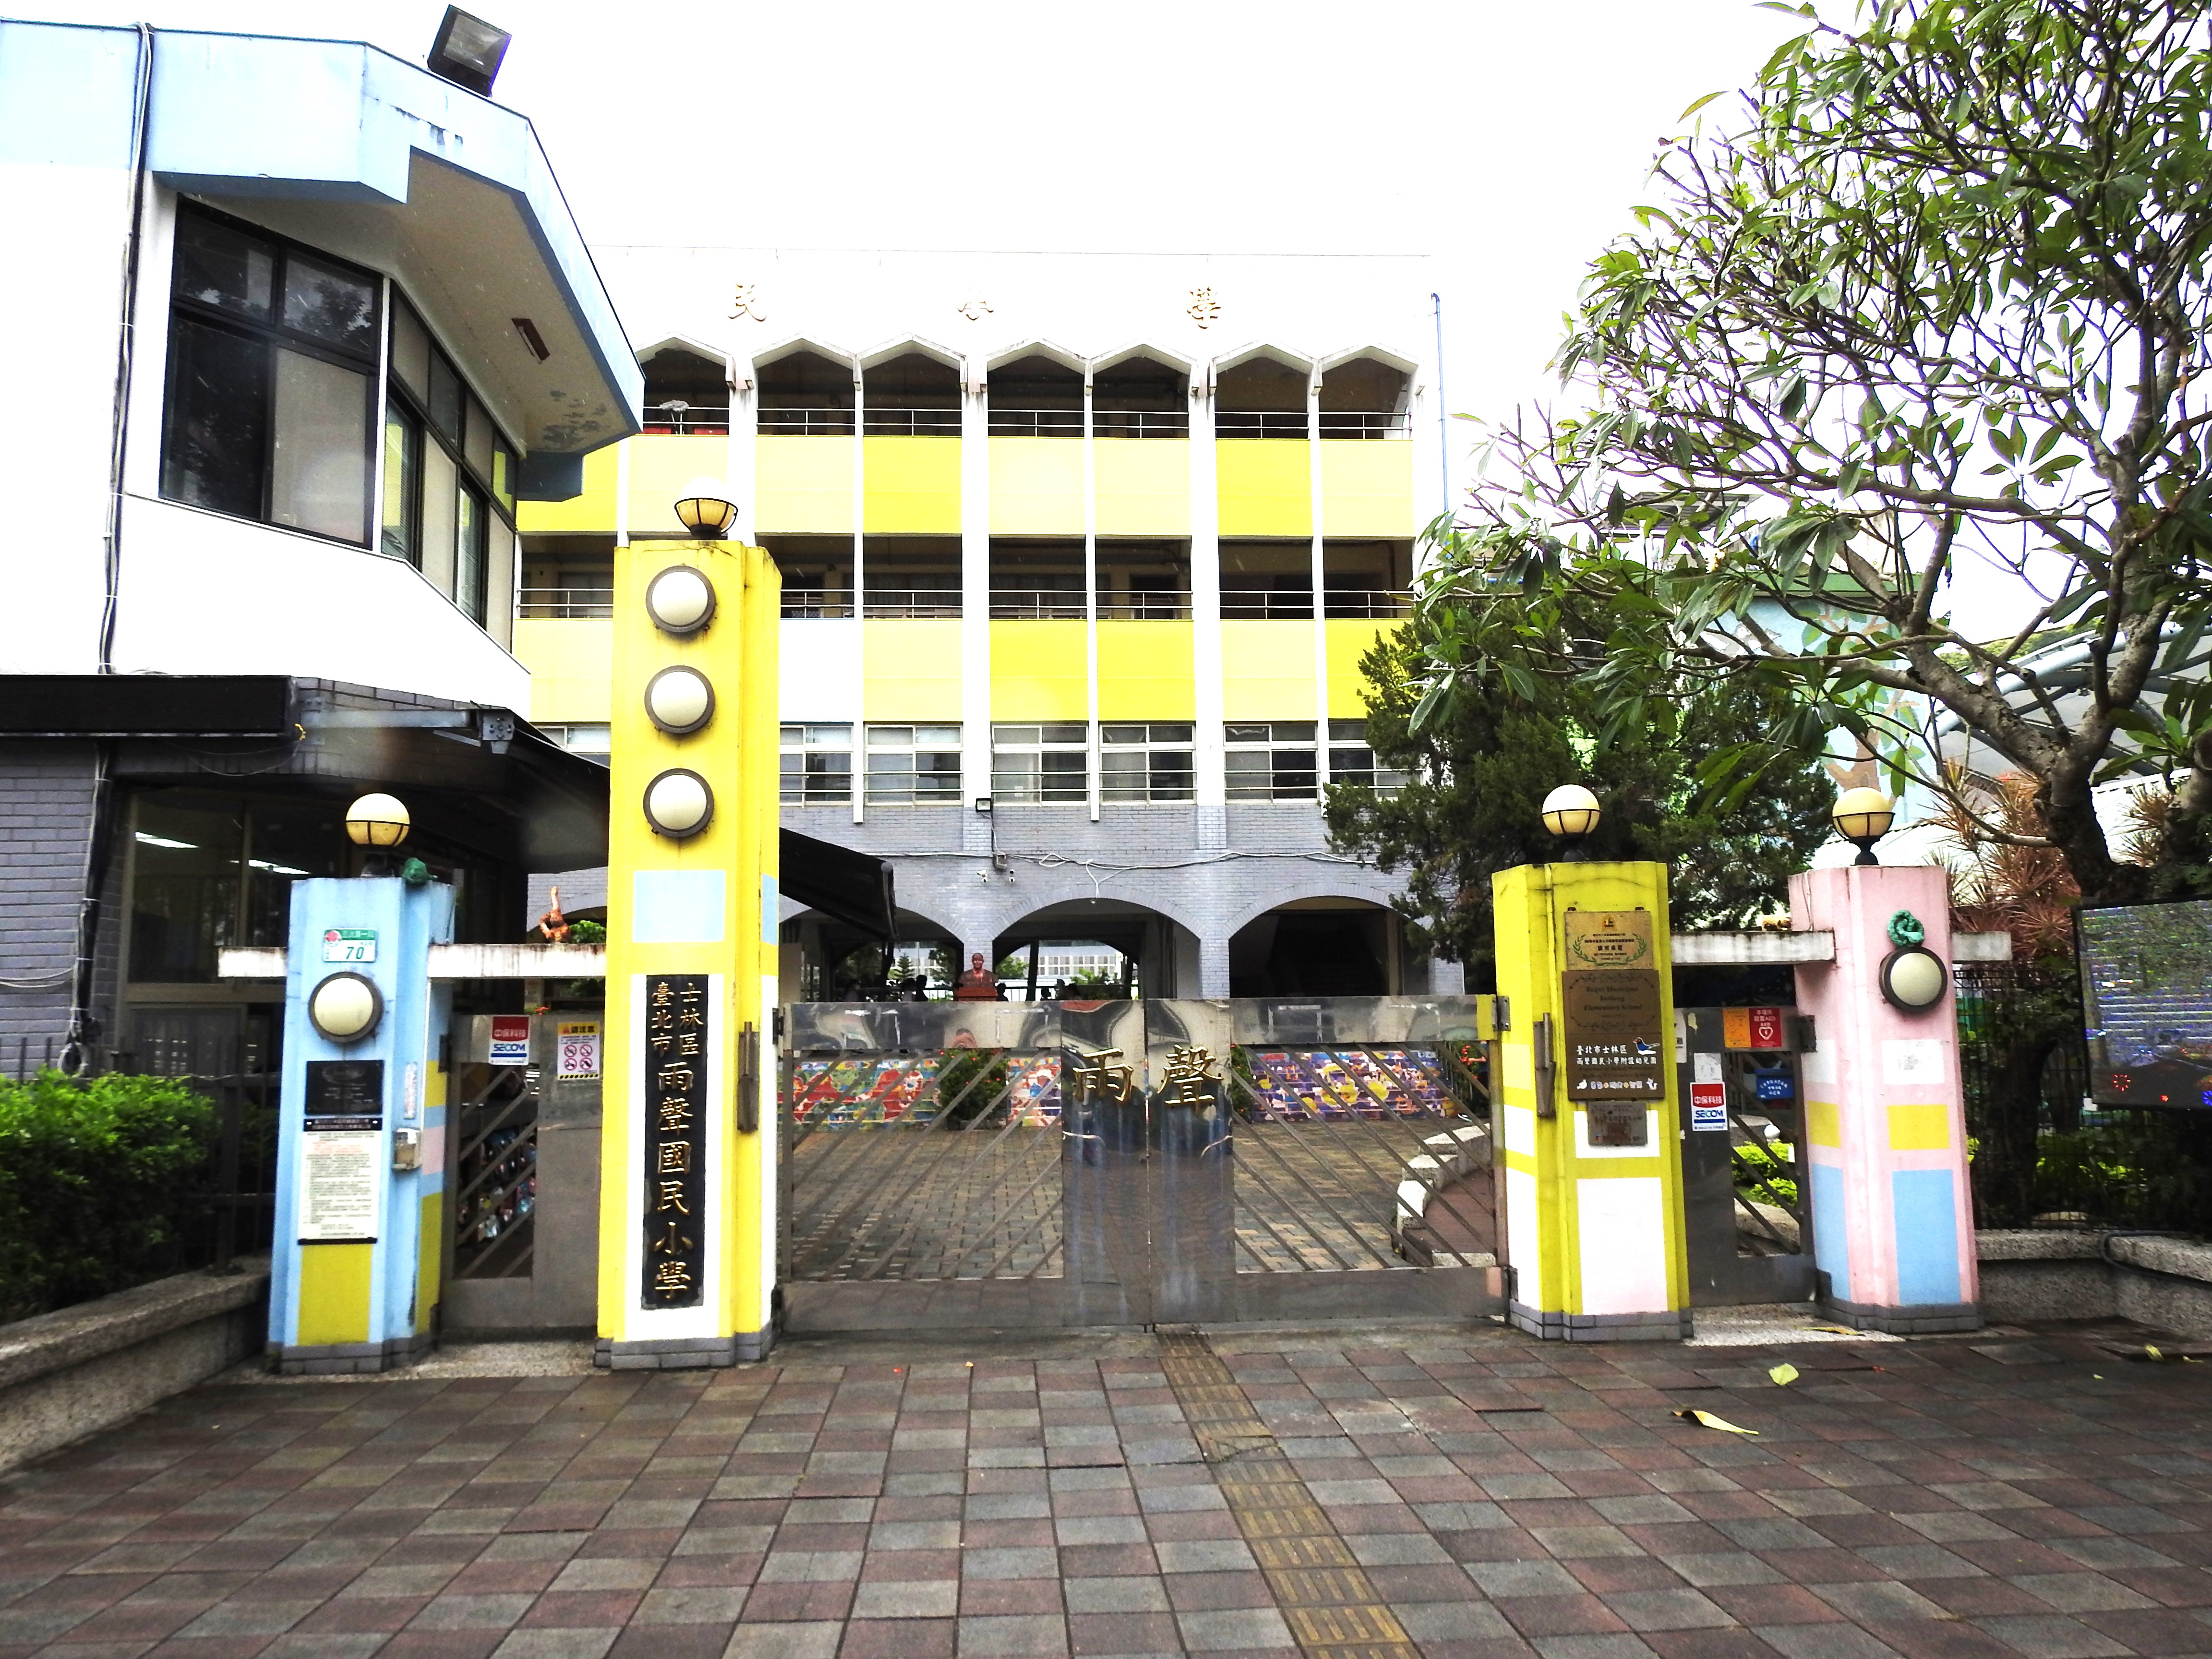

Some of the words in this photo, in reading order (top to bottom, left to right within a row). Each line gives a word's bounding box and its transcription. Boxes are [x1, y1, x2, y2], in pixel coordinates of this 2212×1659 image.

[346, 946, 364, 960] 70
[651, 982, 674, 1058] 臺北市
[679, 982, 704, 1057] 士林區
[494, 1029, 526, 1037] 中保科技
[493, 1043, 526, 1052] SECOM
[1576, 1045, 1627, 1055] 臺北市士林區
[1072, 1044, 1225, 1115] 雨聲
[1695, 1095, 1723, 1104] 中保科技
[1695, 1109, 1723, 1118] SECOM
[654, 1061, 694, 1300] 雨聲國民小學
